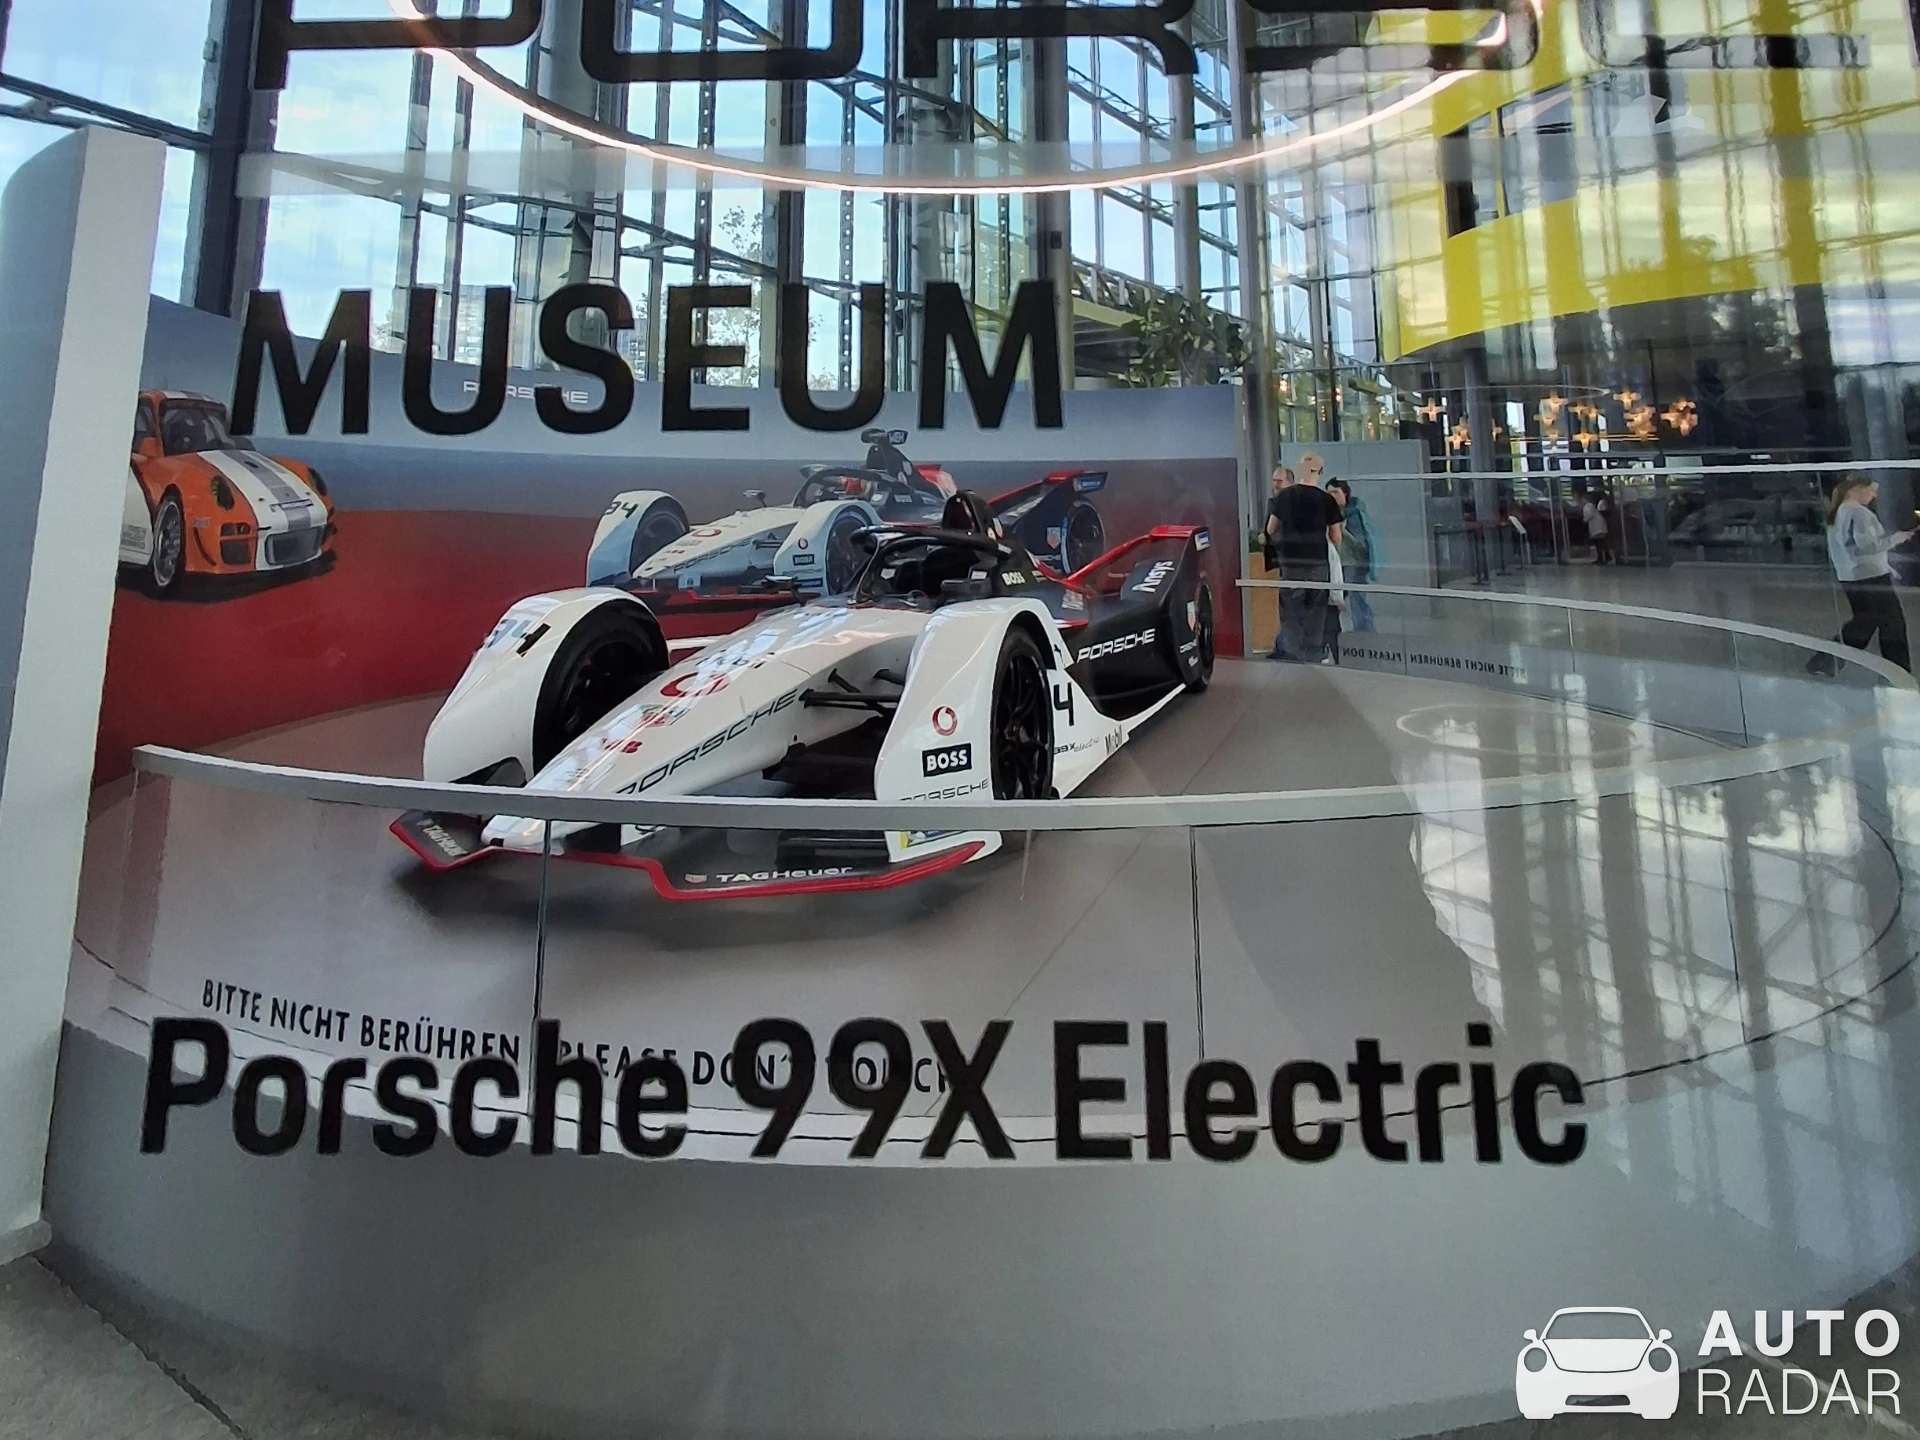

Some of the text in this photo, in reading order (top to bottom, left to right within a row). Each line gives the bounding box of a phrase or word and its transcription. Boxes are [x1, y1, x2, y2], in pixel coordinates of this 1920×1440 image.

[230, 281, 1064, 436] MUSEUM
[1001, 571, 1026, 586] BOSS
[1076, 628, 1156, 663] PORSCHE
[925, 748, 969, 773] BOSS
[899, 777, 990, 801] ORSCHE
[203, 979, 262, 1024] BITTE
[269, 996, 351, 1043] NICHT
[360, 1014, 520, 1064] BERÜHREN
[140, 1016, 1587, 1163] Porsche 99X Electric
